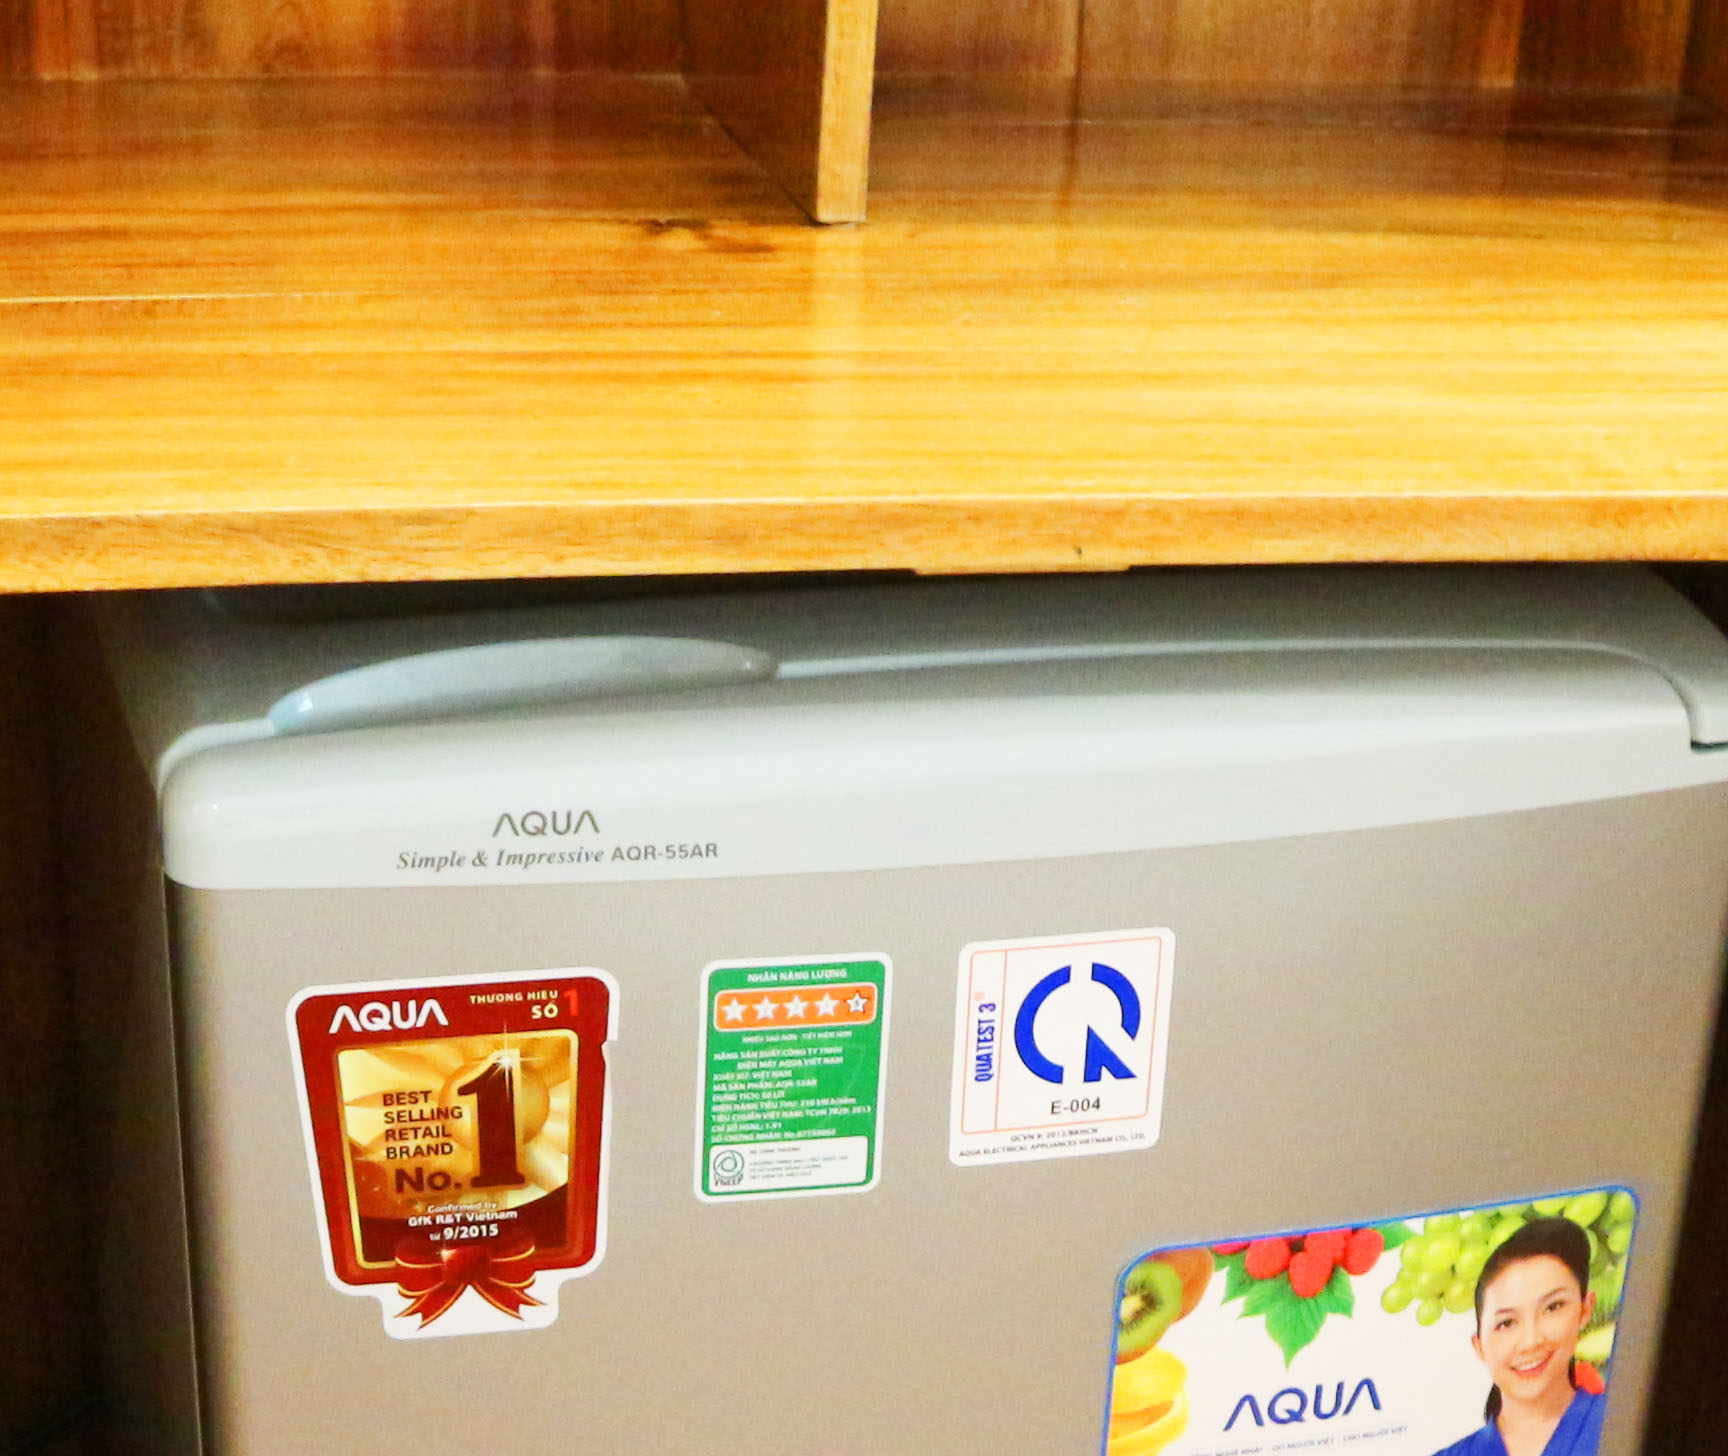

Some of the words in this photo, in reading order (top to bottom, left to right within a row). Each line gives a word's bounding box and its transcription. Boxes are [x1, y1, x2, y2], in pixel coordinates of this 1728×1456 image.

[491, 808, 601, 838] AQUA
[396, 850, 466, 872] Simple
[471, 850, 489, 868] &
[495, 845, 605, 871] Impressive
[611, 843, 718, 863] AQR-55AR
[563, 988, 579, 1017] 1
[978, 1002, 997, 1014] 3
[329, 998, 449, 1034] AQUA
[974, 1018, 995, 1082] QUATEST
[382, 1089, 432, 1107] BEST
[1050, 1096, 1102, 1116] E-004
[384, 1106, 463, 1124] SELLING
[457, 1049, 526, 1188] 1
[385, 1124, 452, 1142] RETAIL
[386, 1142, 454, 1160] BRAND
[394, 1167, 463, 1193] No.
[465, 1210, 518, 1222] Vietnam
[443, 1223, 499, 1240] 9/2015
[1222, 1377, 1382, 1432] AQUA
